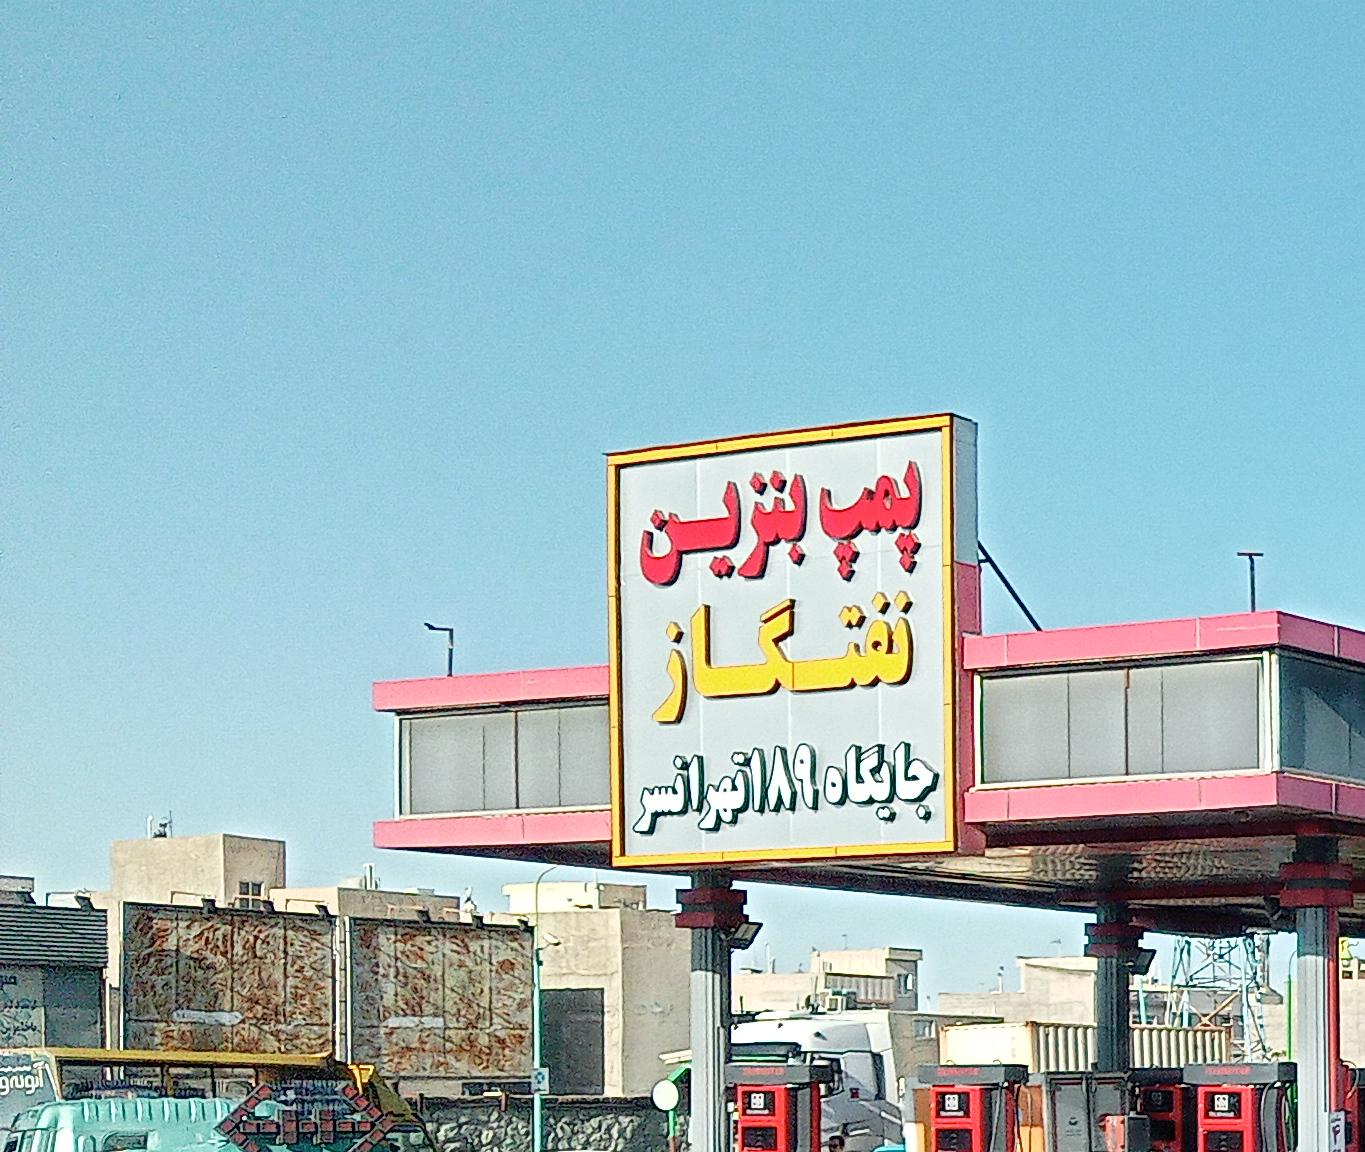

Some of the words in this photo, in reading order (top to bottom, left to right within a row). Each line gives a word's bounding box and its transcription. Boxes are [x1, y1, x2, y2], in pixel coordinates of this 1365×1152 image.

[639, 470, 808, 586] بنزین
[819, 460, 923, 582] پمپ
[633, 751, 751, 834] تهرانسر
[751, 743, 820, 813] ۱۸۹
[824, 741, 939, 822] جایگاه
